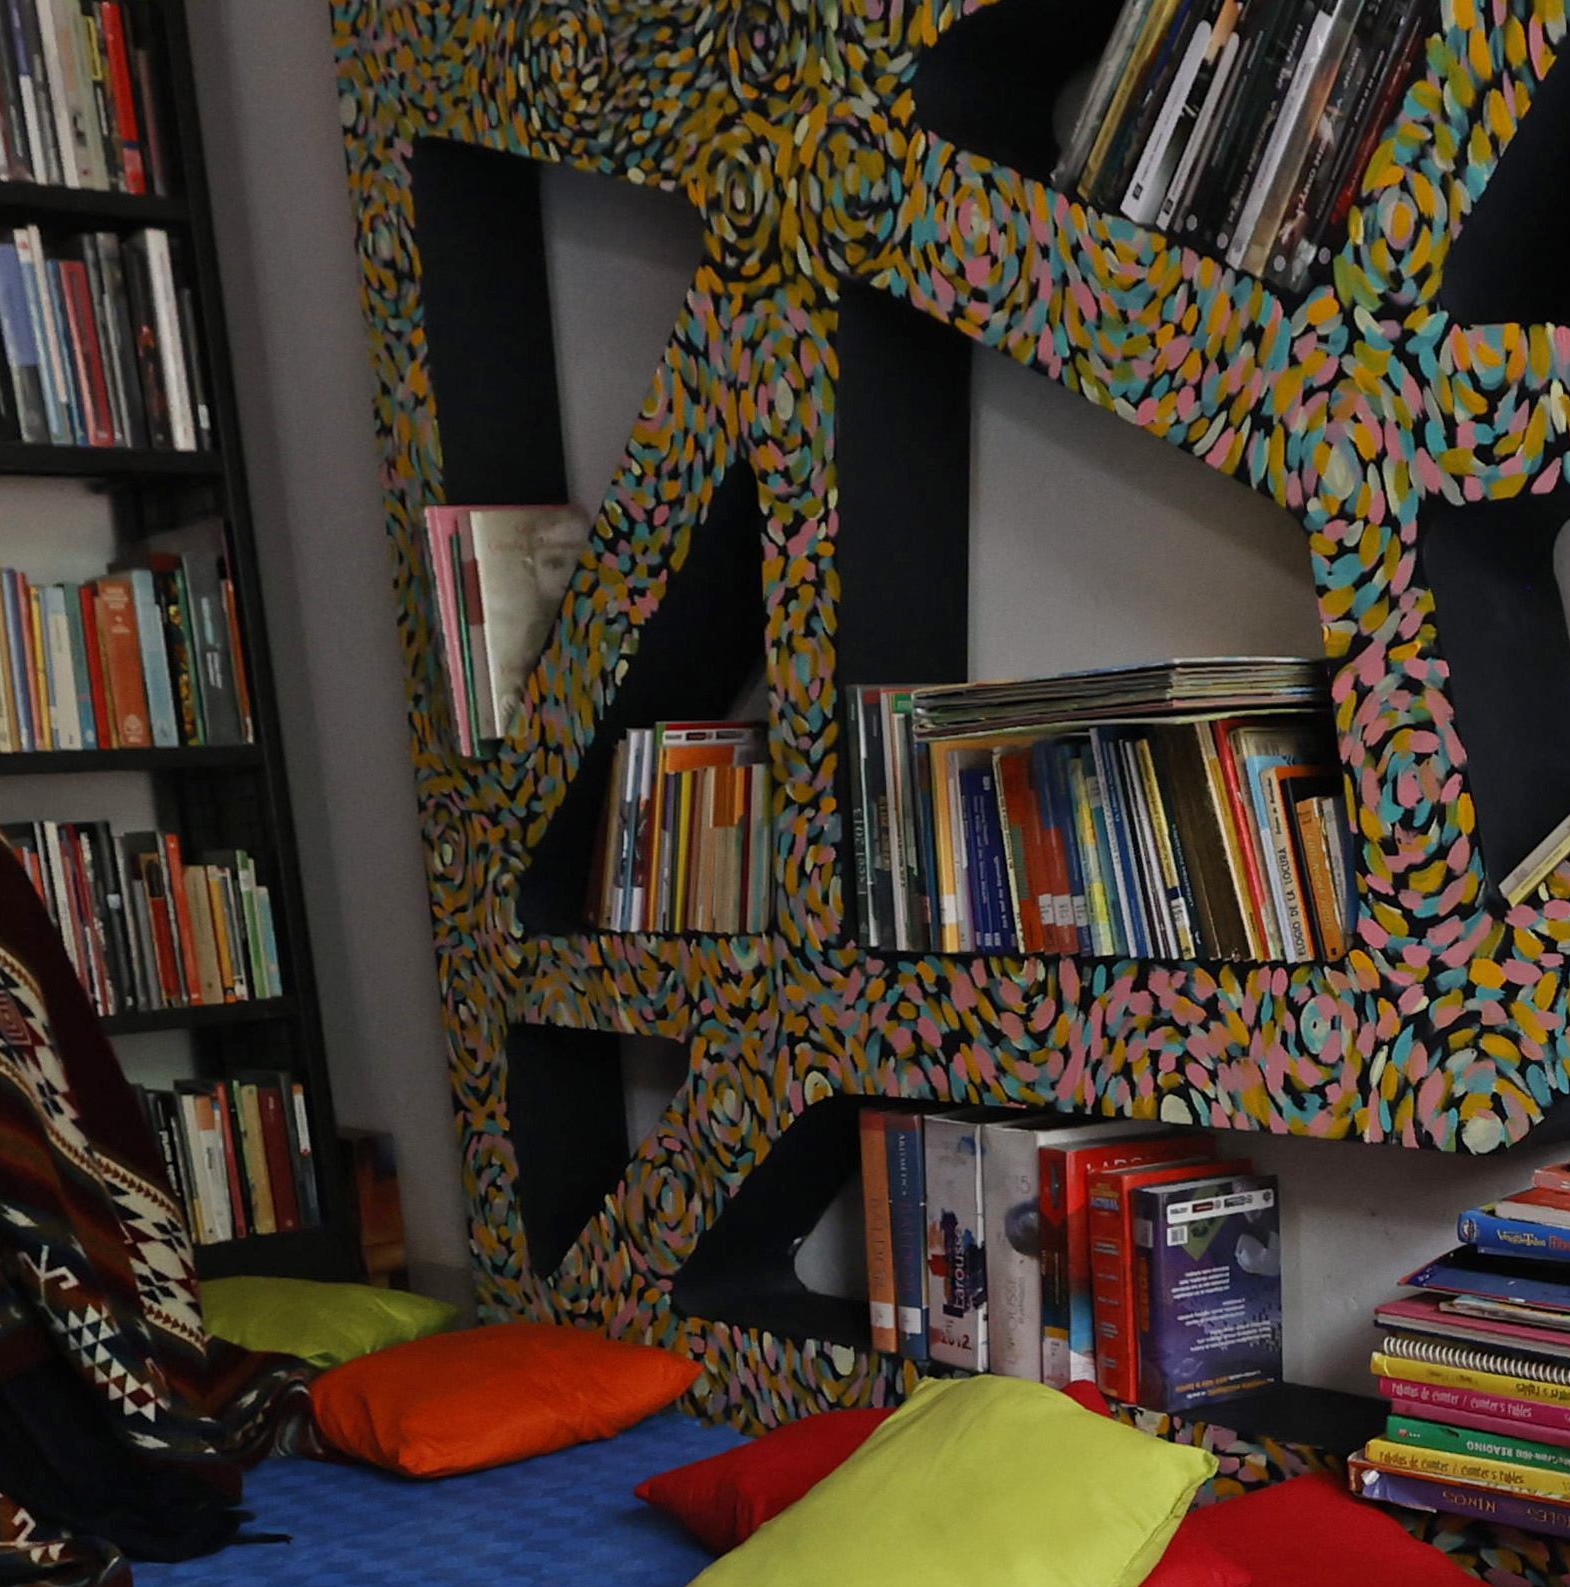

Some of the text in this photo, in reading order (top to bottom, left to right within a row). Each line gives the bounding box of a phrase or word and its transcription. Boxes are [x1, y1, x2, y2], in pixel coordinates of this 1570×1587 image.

[1278, 847, 1293, 887] LOCURA
[1285, 889, 1295, 902] LA
[1289, 904, 1301, 918] DE
[1291, 920, 1307, 957] ELOGIO
[1466, 1440, 1513, 1457] READING
